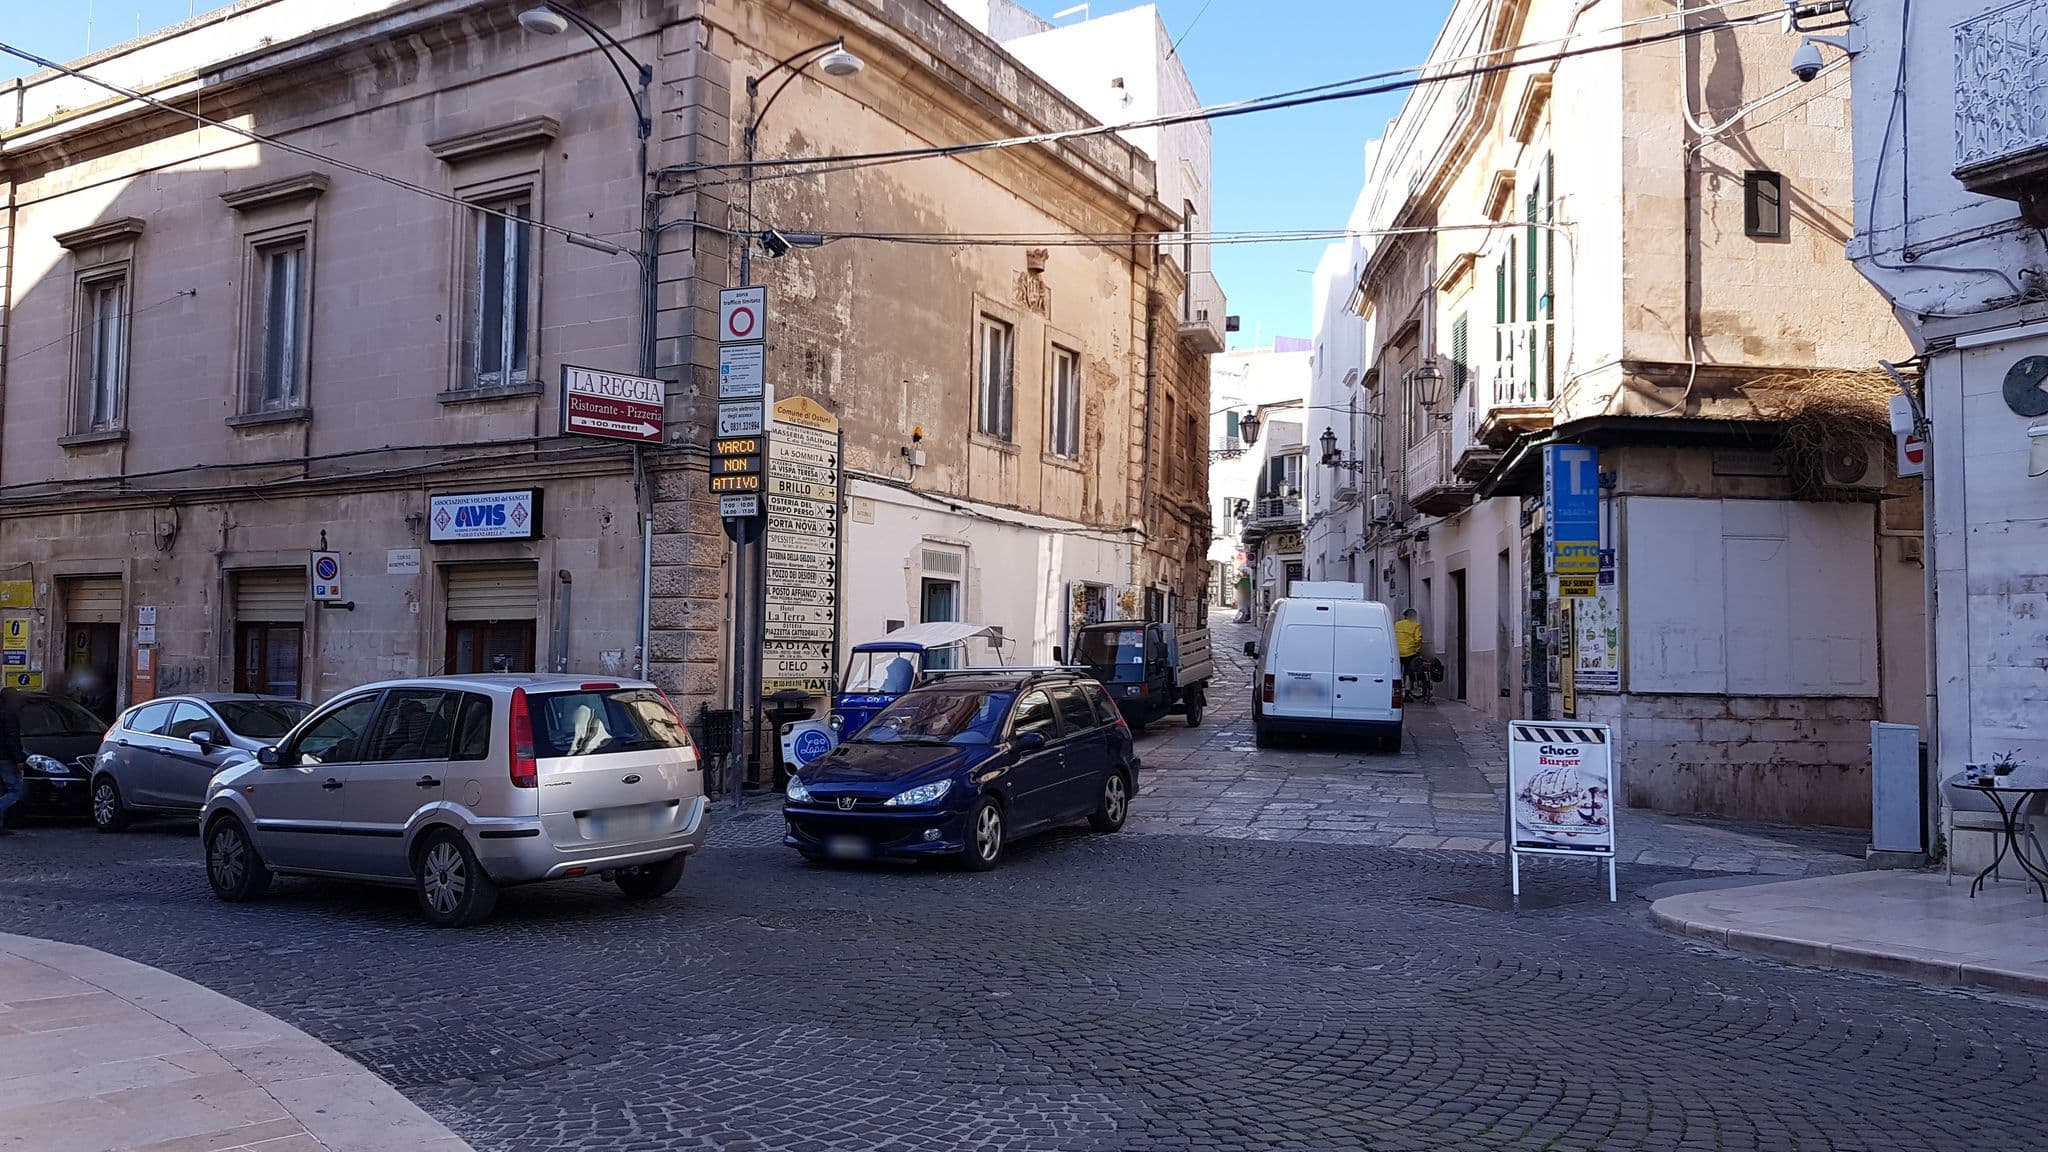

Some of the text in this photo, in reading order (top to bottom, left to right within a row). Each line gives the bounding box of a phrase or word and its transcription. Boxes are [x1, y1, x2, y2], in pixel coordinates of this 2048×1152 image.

[572, 372, 661, 402] LA REGGIA
[571, 398, 618, 415] Ristorante
[627, 405, 662, 420] Pizzeria
[777, 406, 803, 418] Comune
[811, 414, 831, 424] Ostuni
[611, 423, 638, 431] metri
[772, 428, 837, 447] MASSERIA SALINOLA
[717, 441, 755, 454] VARCO
[780, 448, 789, 456] LA
[724, 459, 747, 471] NON
[779, 466, 796, 474] VISPA
[797, 469, 819, 477] TERESA
[1560, 449, 1591, 496] T
[712, 476, 758, 490] ATTIVO
[779, 481, 811, 494] BRILLO
[771, 497, 813, 509] OSTERIA DEL
[1545, 450, 1553, 568] TABACCHI
[455, 504, 506, 528] AVIS
[768, 505, 815, 516] TEMPO PERSO
[769, 518, 793, 529] PORTA
[795, 521, 817, 531] NOVA
[768, 551, 787, 560] TAVERNA
[787, 553, 799, 561] DELLA
[1554, 545, 1600, 558] LOTTO
[772, 569, 789, 578] POZZO
[772, 587, 790, 596] POSTO
[791, 589, 817, 598] AFFIANCO
[768, 611, 805, 621] La Terra
[778, 661, 808, 671] CIELO
[1539, 745, 1579, 756] Choco
[1539, 756, 1581, 767] Burger
